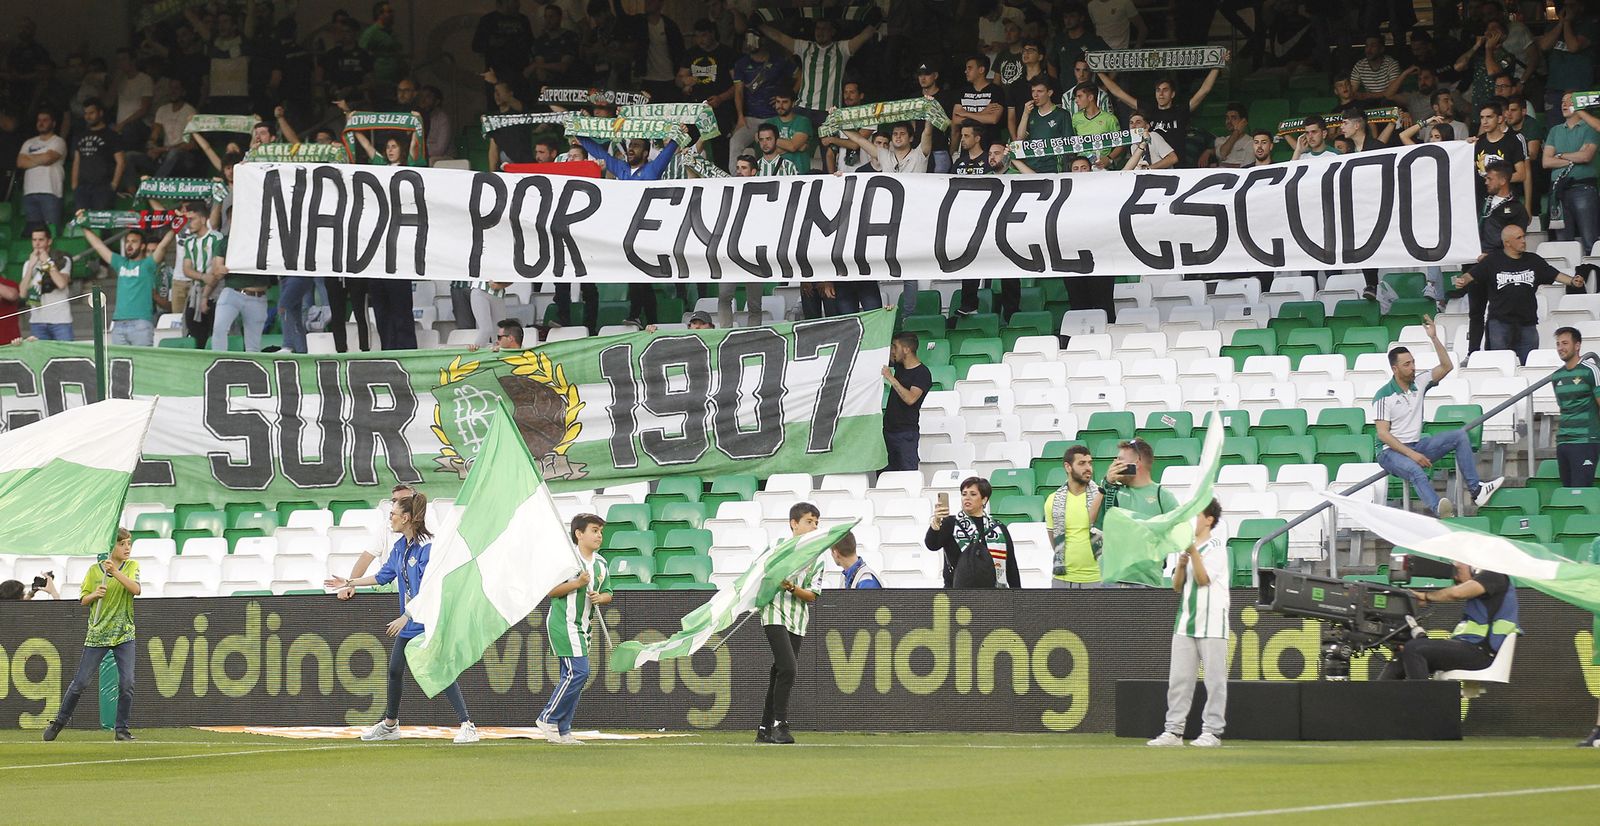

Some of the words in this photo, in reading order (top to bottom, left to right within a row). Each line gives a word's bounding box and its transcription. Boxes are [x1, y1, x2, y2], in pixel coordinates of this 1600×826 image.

[538, 89, 588, 102] SUPPORTERS
[580, 118, 613, 131] REAL
[622, 119, 666, 131] BETIS
[258, 144, 289, 155] REAL
[1023, 140, 1047, 151] Real
[1051, 138, 1075, 149] Betis
[141, 182, 157, 191] Real
[159, 182, 176, 192] Betis
[256, 166, 428, 276] NADA
[469, 172, 602, 278] POR
[622, 175, 905, 279] ENCIMA
[934, 178, 1094, 274] DEL
[1119, 144, 1452, 270] ESCUDO
[204, 357, 425, 490] SUR
[599, 316, 865, 469] 1907
[149, 601, 388, 726] viding
[483, 609, 732, 728] viing
[825, 593, 1090, 732] viding
